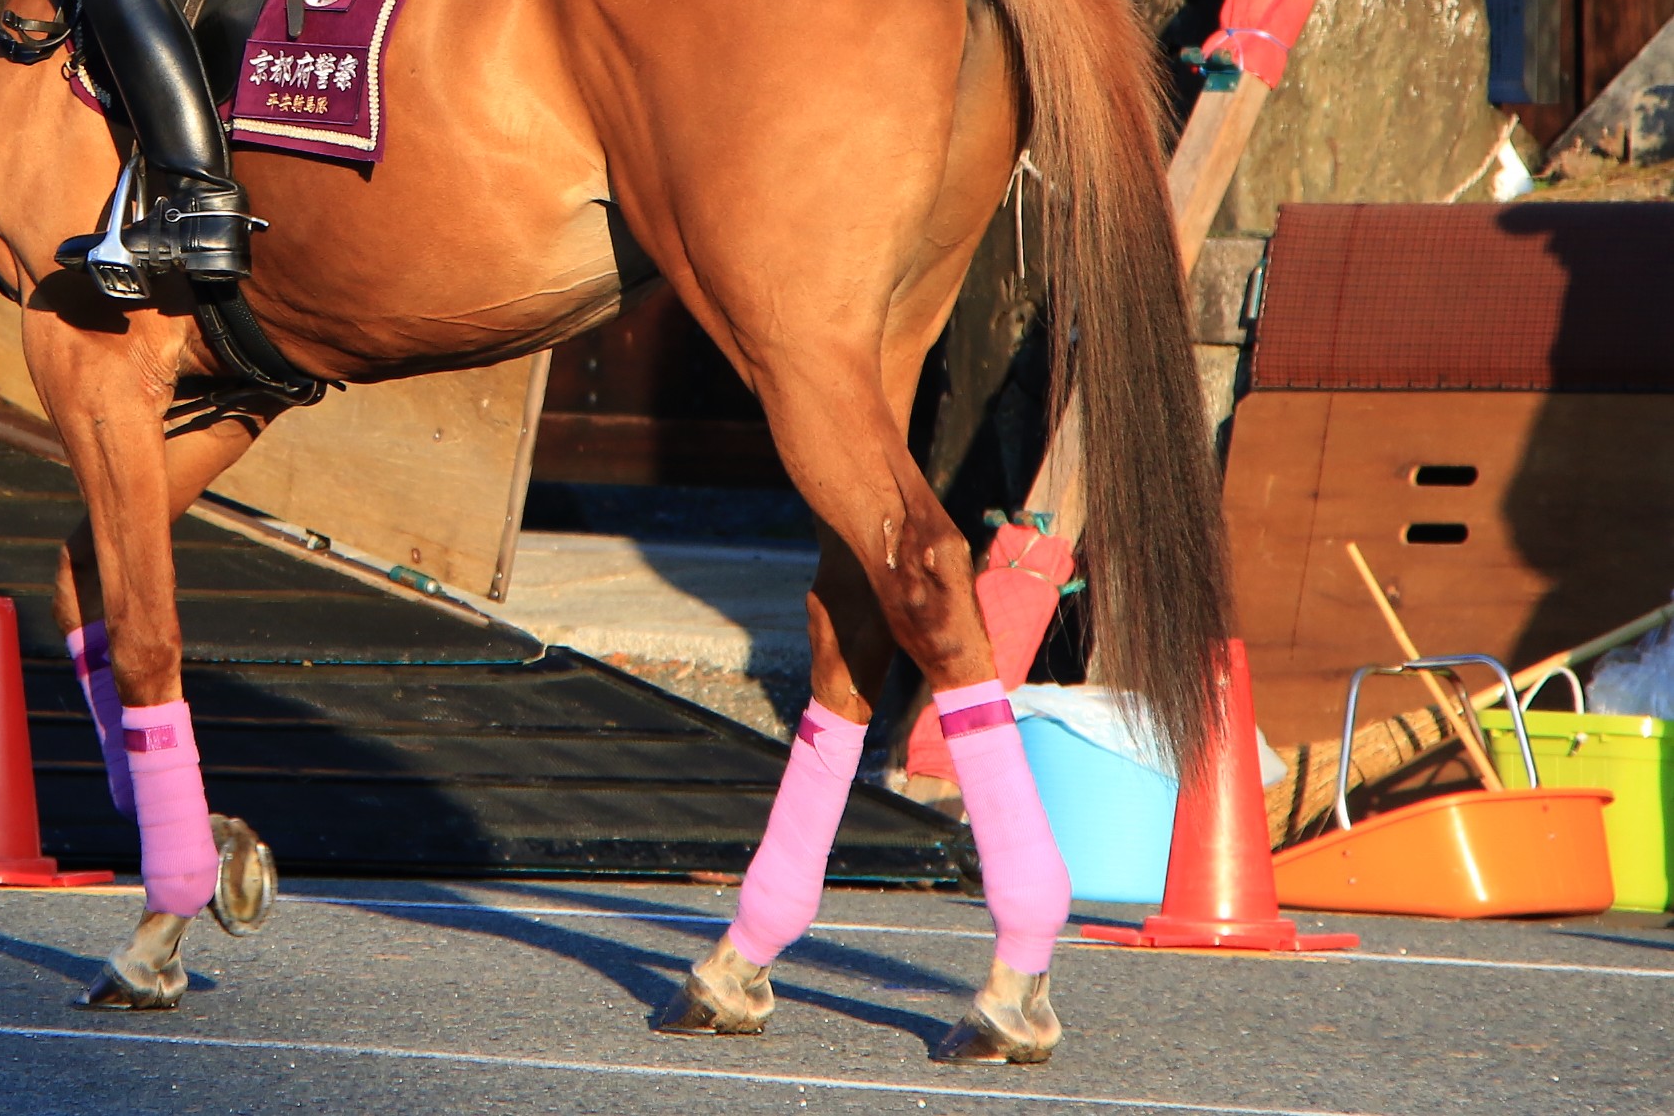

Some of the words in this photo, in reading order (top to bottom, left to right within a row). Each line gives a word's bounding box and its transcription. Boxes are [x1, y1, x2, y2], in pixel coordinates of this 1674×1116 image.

[249, 49, 358, 91] 京都府警察
